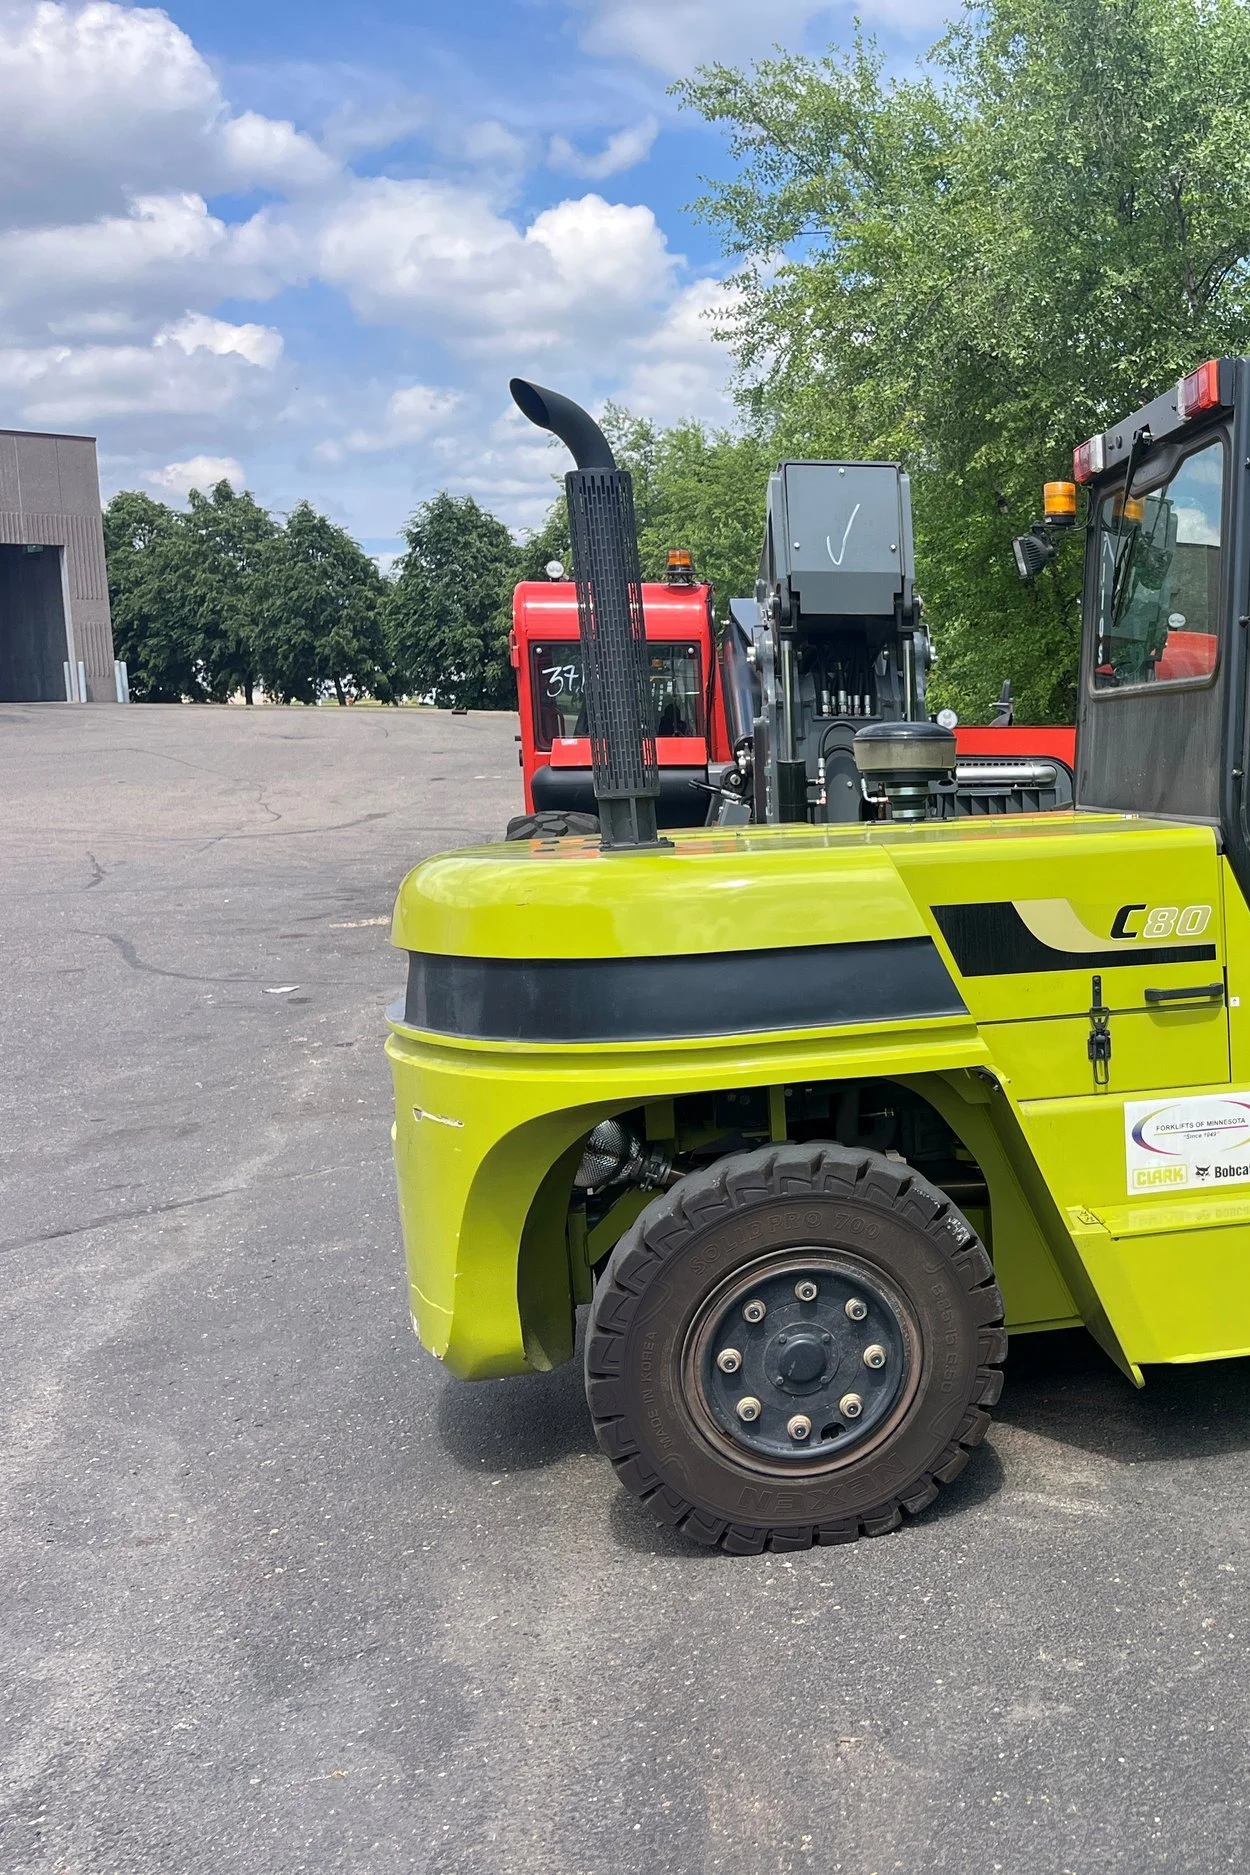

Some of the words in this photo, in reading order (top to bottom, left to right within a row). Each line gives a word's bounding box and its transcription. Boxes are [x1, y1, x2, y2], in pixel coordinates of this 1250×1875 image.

[1110, 904, 1212, 941] C80
[1156, 1123, 1194, 1131] FORKLIFTS
[1207, 1117, 1246, 1127] MINNESOTA
[1137, 1168, 1184, 1186] CLARK
[833, 1212, 881, 1240] 700
[640, 1331, 658, 1383] KOREA
[642, 1389, 655, 1404] IN
[648, 1409, 673, 1449] MADE
[735, 1452, 906, 1514] NEXEN
